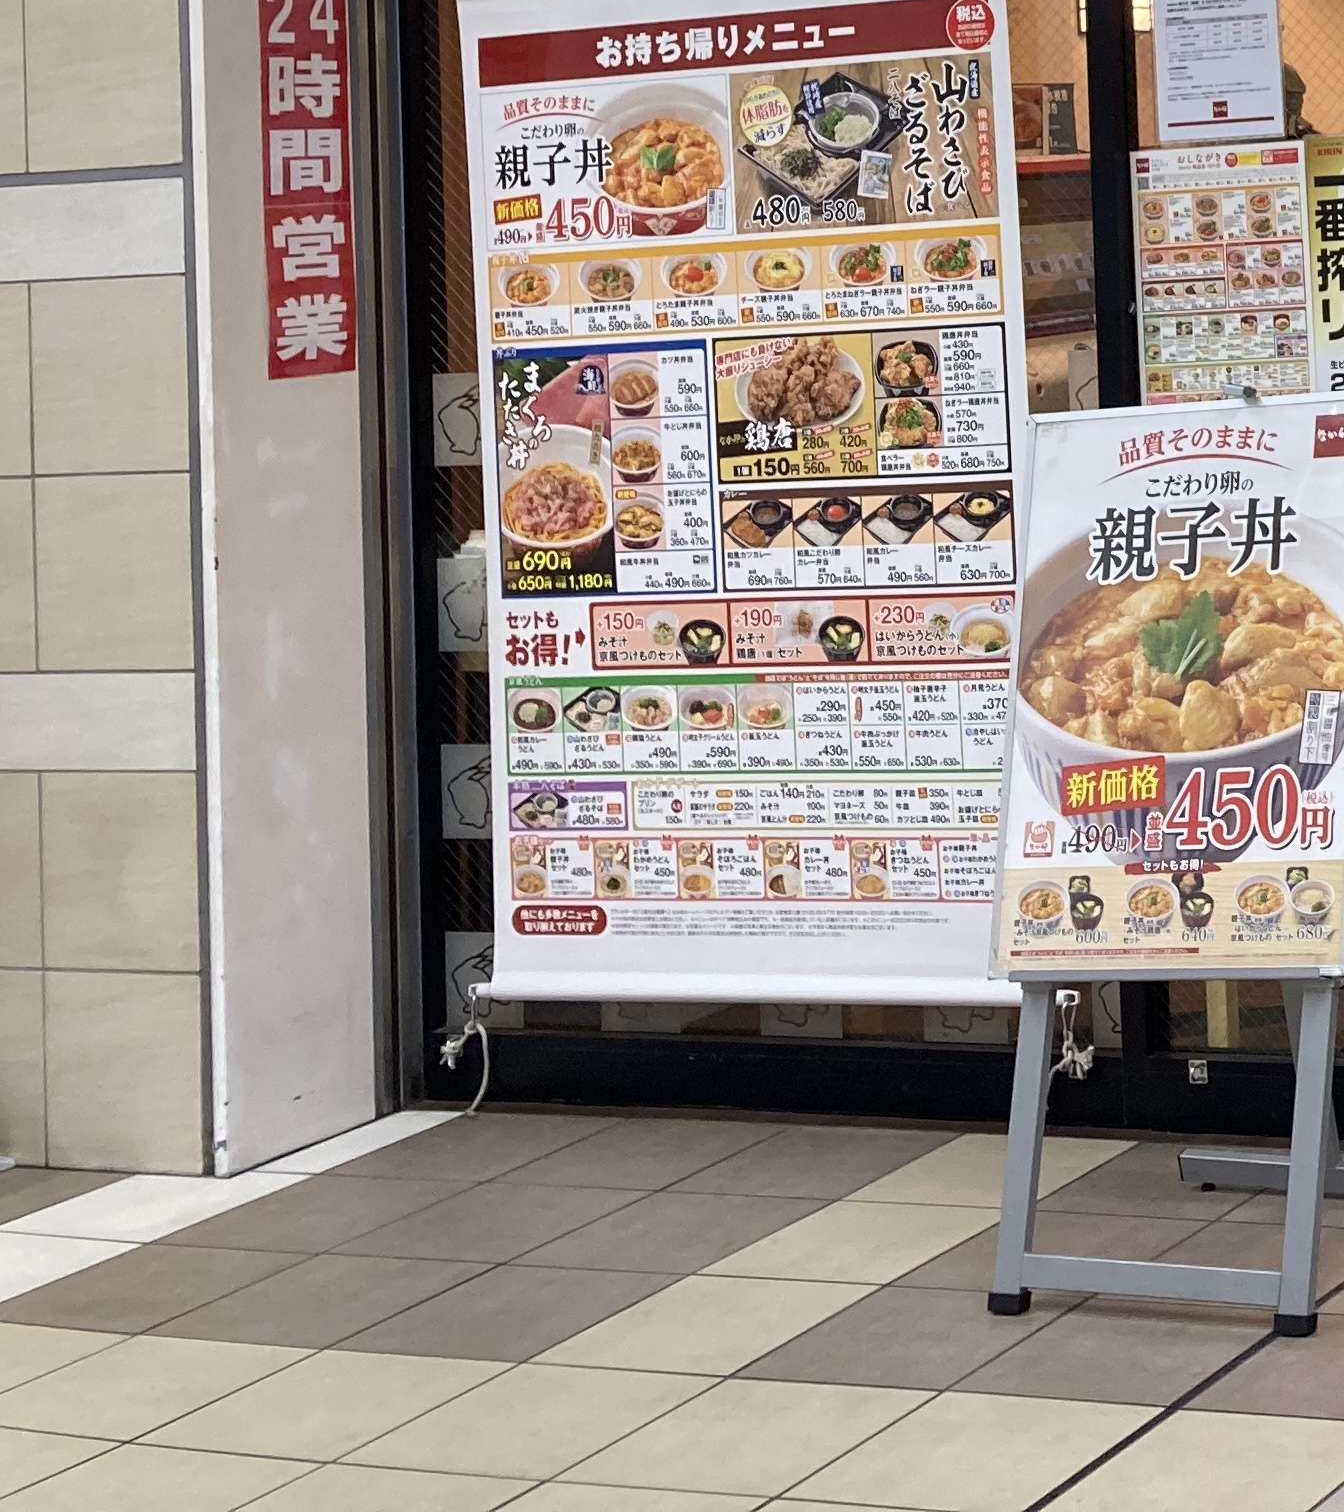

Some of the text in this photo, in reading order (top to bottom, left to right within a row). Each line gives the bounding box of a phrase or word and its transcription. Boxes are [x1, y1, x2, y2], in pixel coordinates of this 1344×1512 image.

[955, 5, 987, 22] 税込
[595, 22, 856, 68] お持ち帰りメニュー
[503, 95, 596, 121] 品質そのままに
[520, 122, 585, 139] こだわり卵の
[753, 124, 787, 143] 減らす
[932, 62, 970, 201] 山わさび
[903, 72, 934, 216] ざるそば
[1317, 146, 1344, 157] KIRIN
[494, 137, 613, 190] 親子丼
[495, 196, 540, 222] 新価格
[545, 196, 633, 242] 450円
[1118, 425, 1279, 467] 品質そのままに
[753, 457, 800, 477] 150円
[1145, 470, 1254, 498] こだわり卵の
[1089, 494, 1299, 582] 親子丼
[505, 610, 559, 630] セットも
[598, 636, 628, 648] みそ汁
[735, 633, 766, 645] みそ汁
[876, 644, 965, 657] 京風つけものセット
[599, 650, 682, 663] 京風つけものセット
[1066, 764, 1160, 808] 新価格
[1166, 765, 1336, 850] 450円
